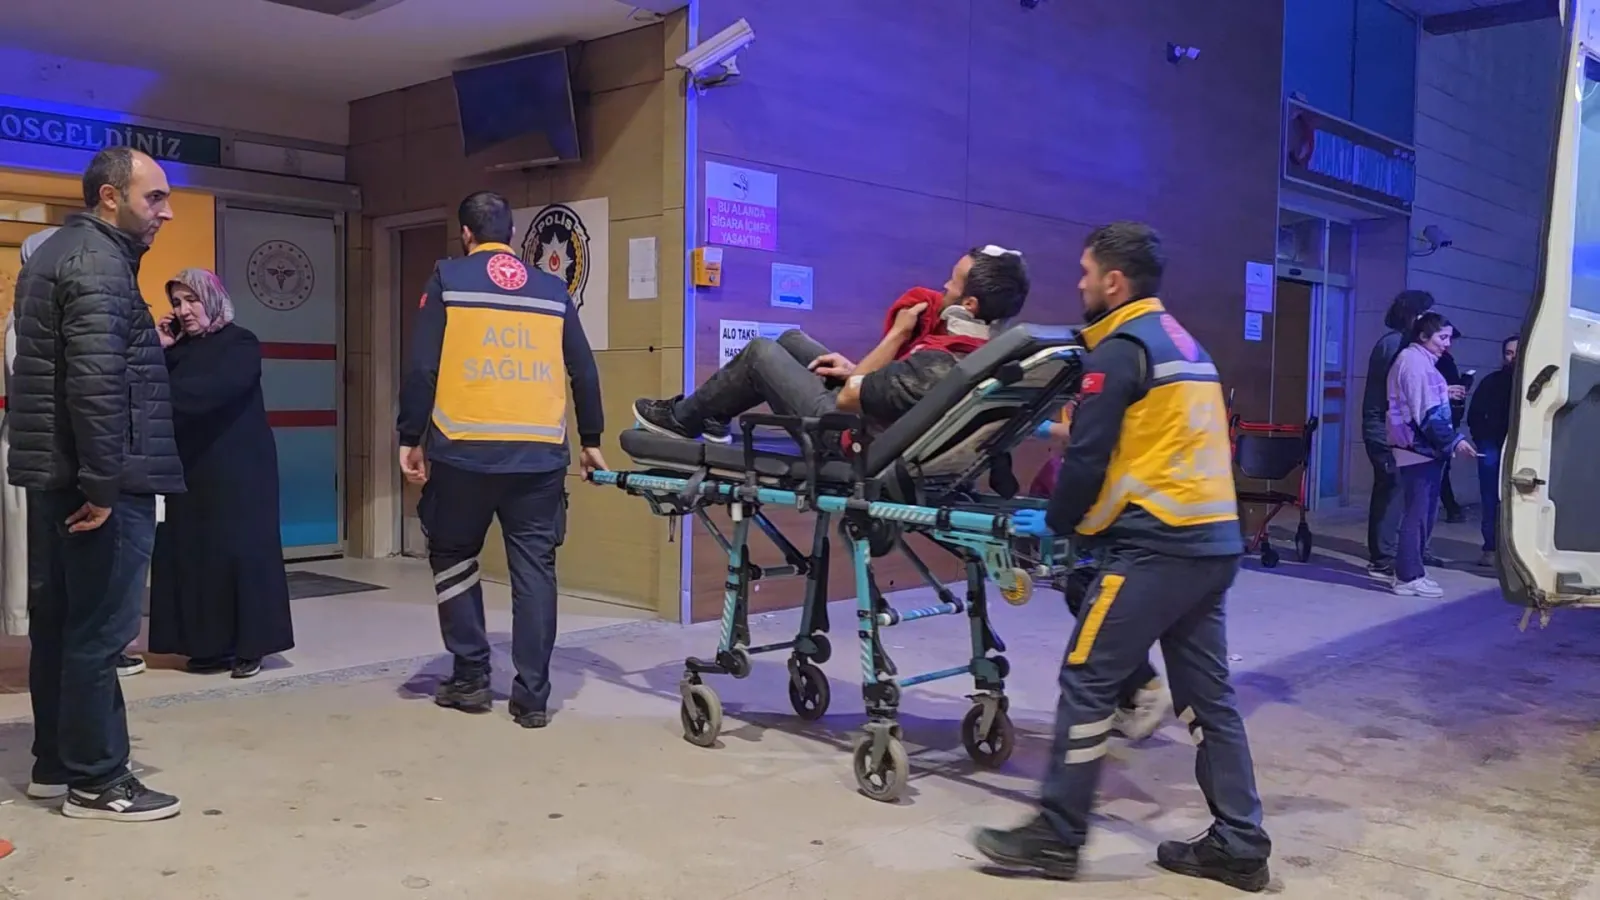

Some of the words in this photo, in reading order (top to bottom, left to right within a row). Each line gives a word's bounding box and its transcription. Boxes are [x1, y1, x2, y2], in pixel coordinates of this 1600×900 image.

[719, 201, 730, 213] BU
[731, 202, 766, 218] ALANDA
[711, 214, 745, 230] SİGARA
[482, 322, 539, 350] ACİL
[723, 328, 737, 340] ALO
[463, 354, 554, 382] SAĞLIK
